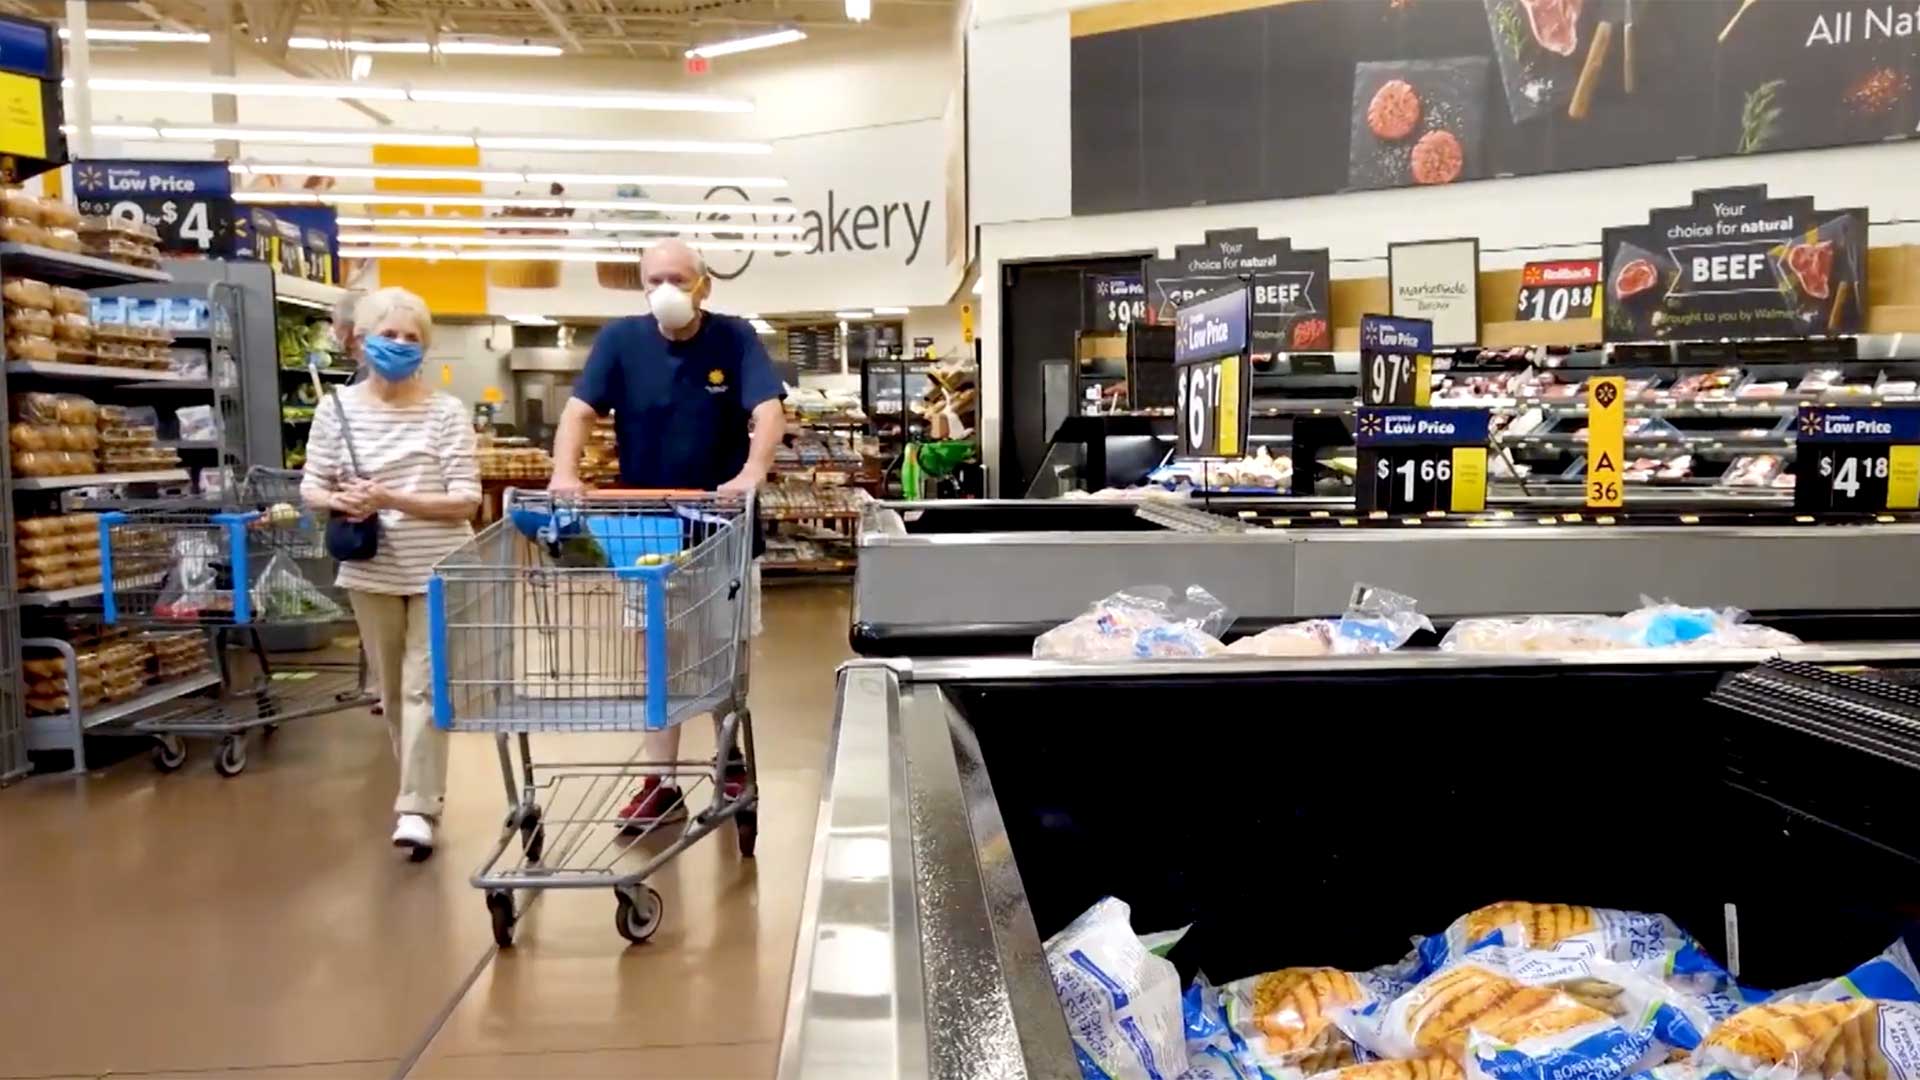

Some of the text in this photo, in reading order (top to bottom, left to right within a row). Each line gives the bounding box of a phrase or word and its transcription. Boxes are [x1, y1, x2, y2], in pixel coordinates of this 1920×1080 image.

[1805, 11, 1851, 47] All
[108, 175, 195, 192] Low Price
[1713, 203, 1746, 217] Your
[1668, 216, 1793, 239] choice for natural
[1219, 242, 1244, 255] Your
[1188, 254, 1277, 272] choice for natural
[1692, 254, 1765, 282] BEEF
[1255, 284, 1300, 305] BEEF
[1718, 312, 1738, 324] you
[1189, 325, 1206, 351] Low
[1207, 317, 1229, 347] Price
[1385, 420, 1455, 434] Low Price
[1825, 420, 1892, 434] Low Price
[1595, 451, 1615, 472] A
[1592, 482, 1618, 501] 36
